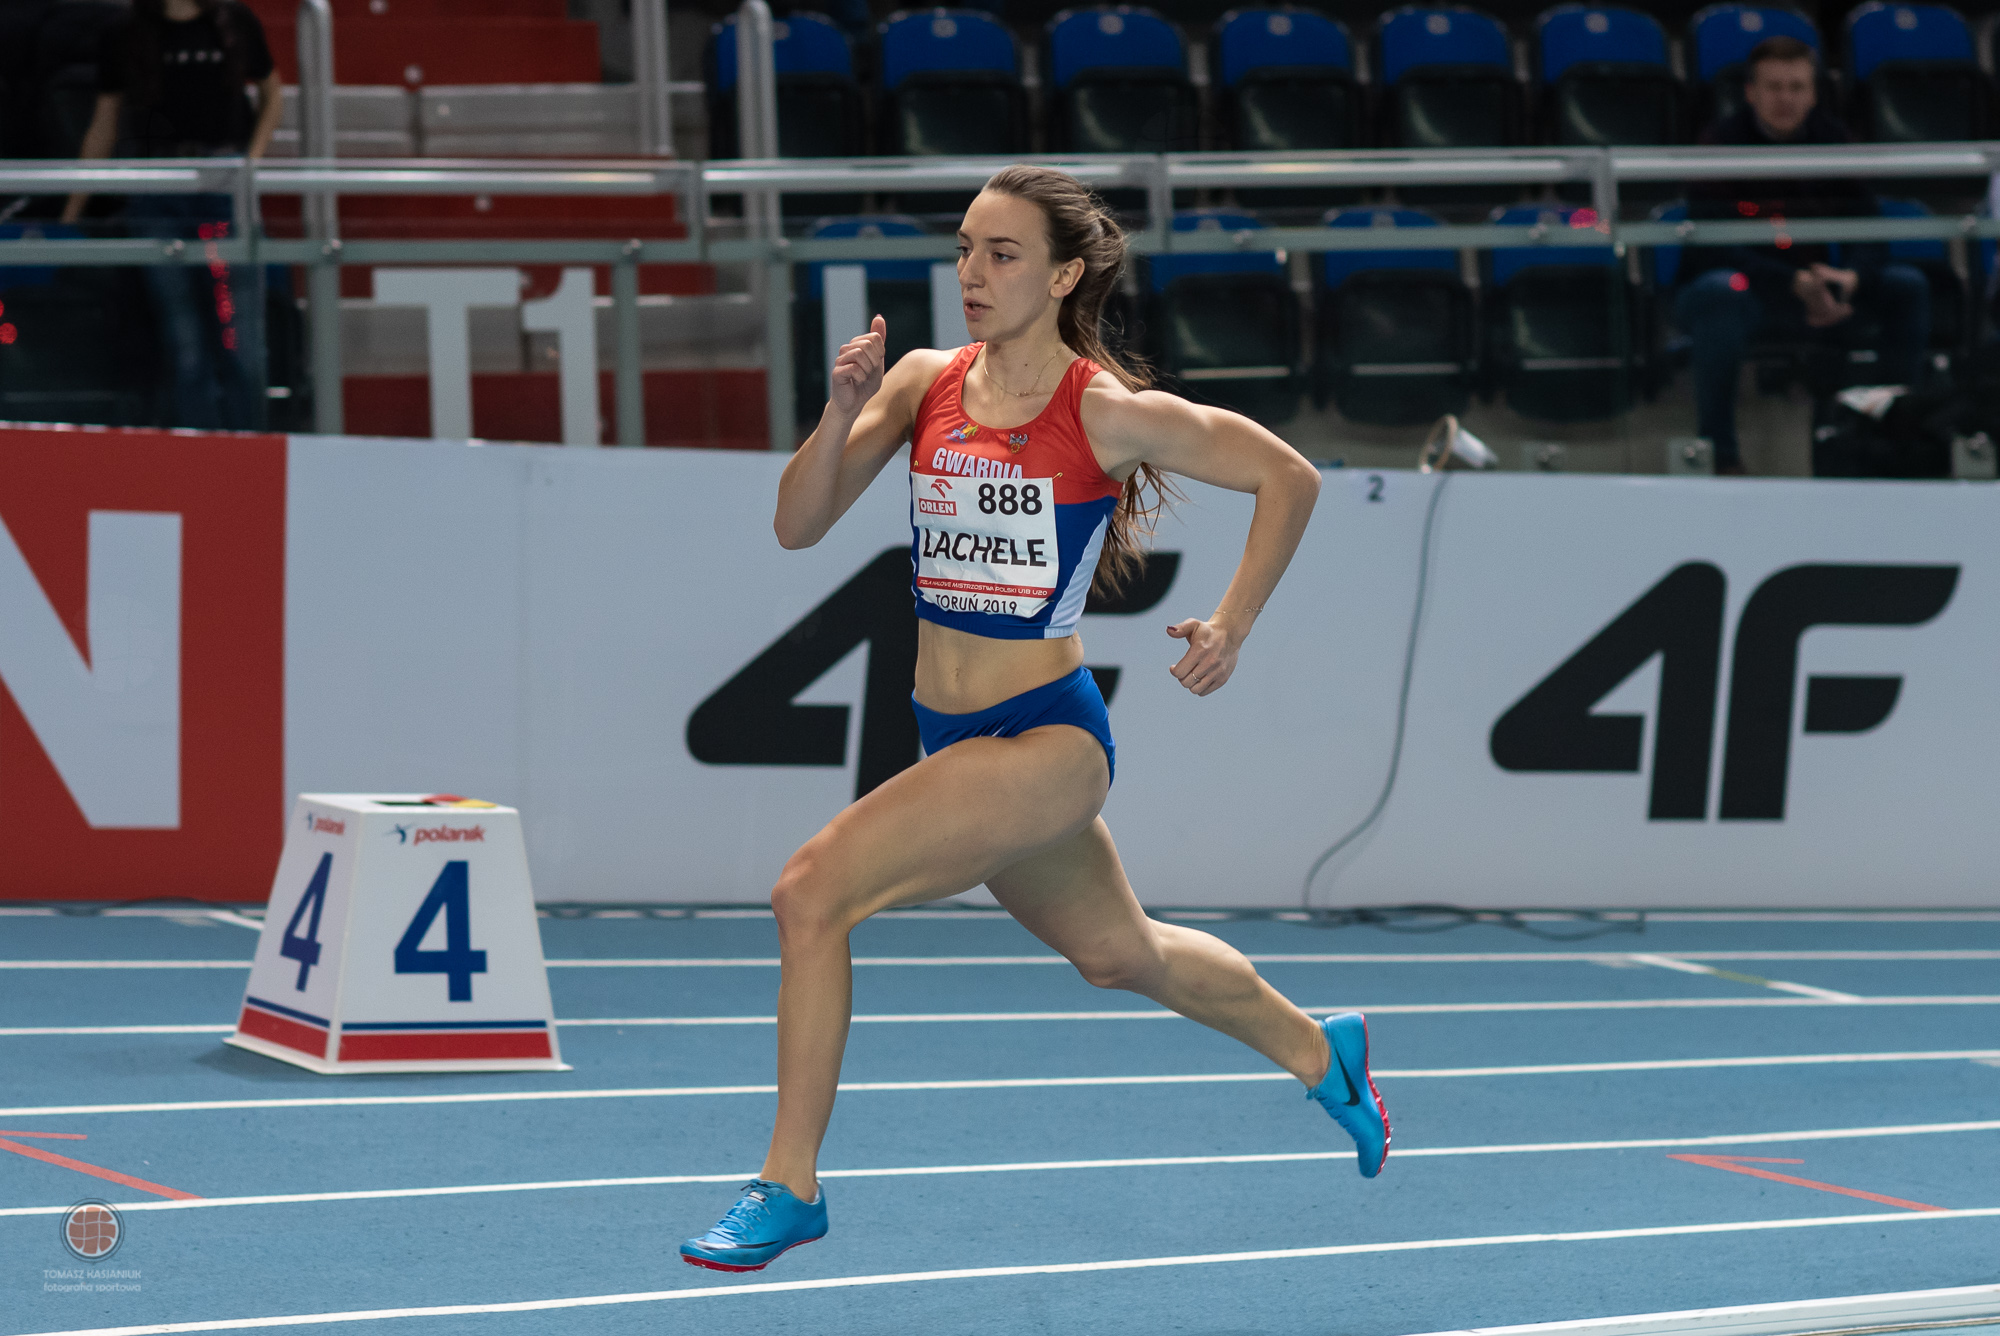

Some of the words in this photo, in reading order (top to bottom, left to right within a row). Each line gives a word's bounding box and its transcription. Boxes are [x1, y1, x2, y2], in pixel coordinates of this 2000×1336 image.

[931, 447, 1023, 479] GWARDIA
[978, 483, 1043, 515] 888
[1368, 475, 1384, 502] 2
[920, 501, 955, 514] ORLEN
[923, 528, 1047, 567] LACHELE
[952, 583, 995, 592] MISTRZOSTWA
[936, 593, 978, 611] TORUŃ
[983, 599, 1018, 615] 2019
[1489, 560, 1961, 821] 4F
[414, 825, 486, 846] polanik
[280, 851, 333, 992] 4
[394, 860, 487, 1002] 4
